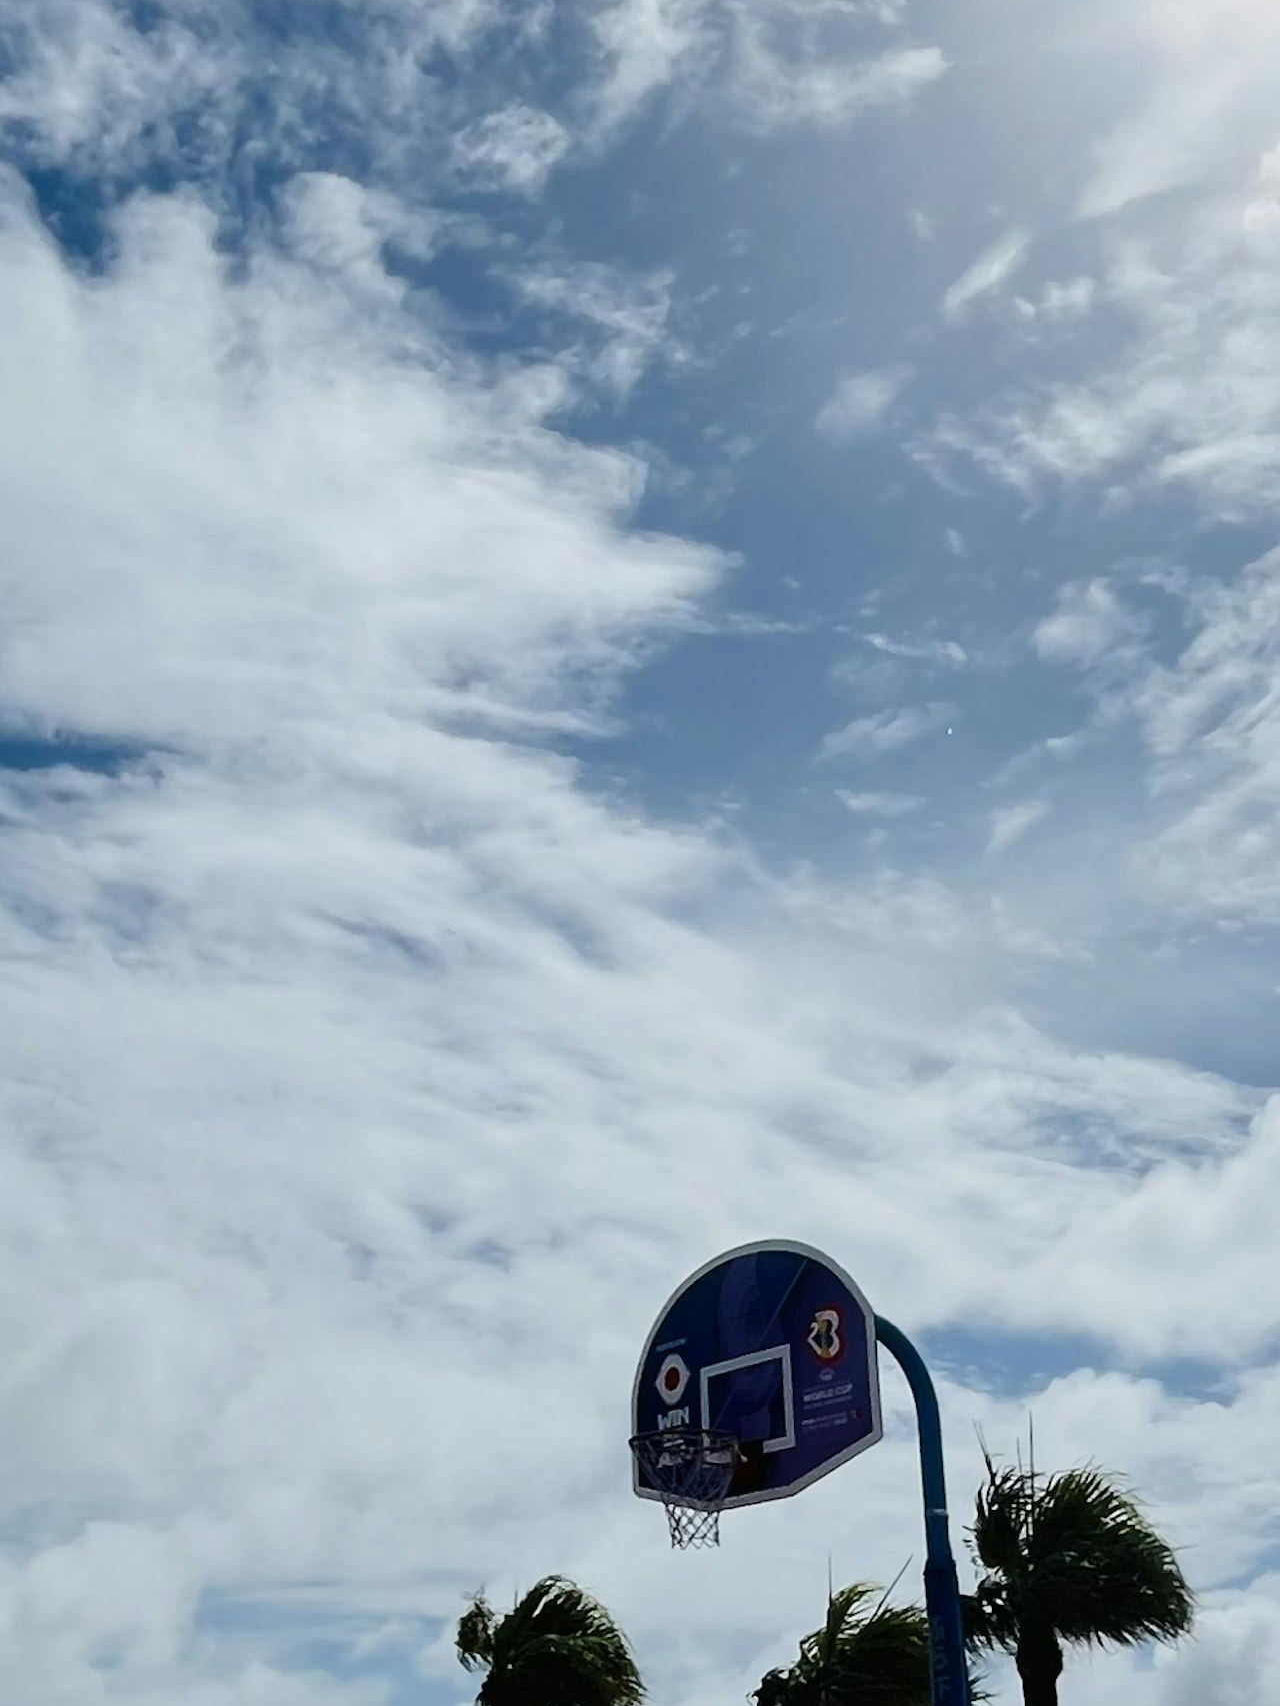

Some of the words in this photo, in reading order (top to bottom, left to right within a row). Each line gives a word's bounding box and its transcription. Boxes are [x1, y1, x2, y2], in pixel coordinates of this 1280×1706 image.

[803, 1388, 834, 1402] WORLD
[835, 1383, 853, 1395] CUP
[657, 1406, 690, 1431] WIN
